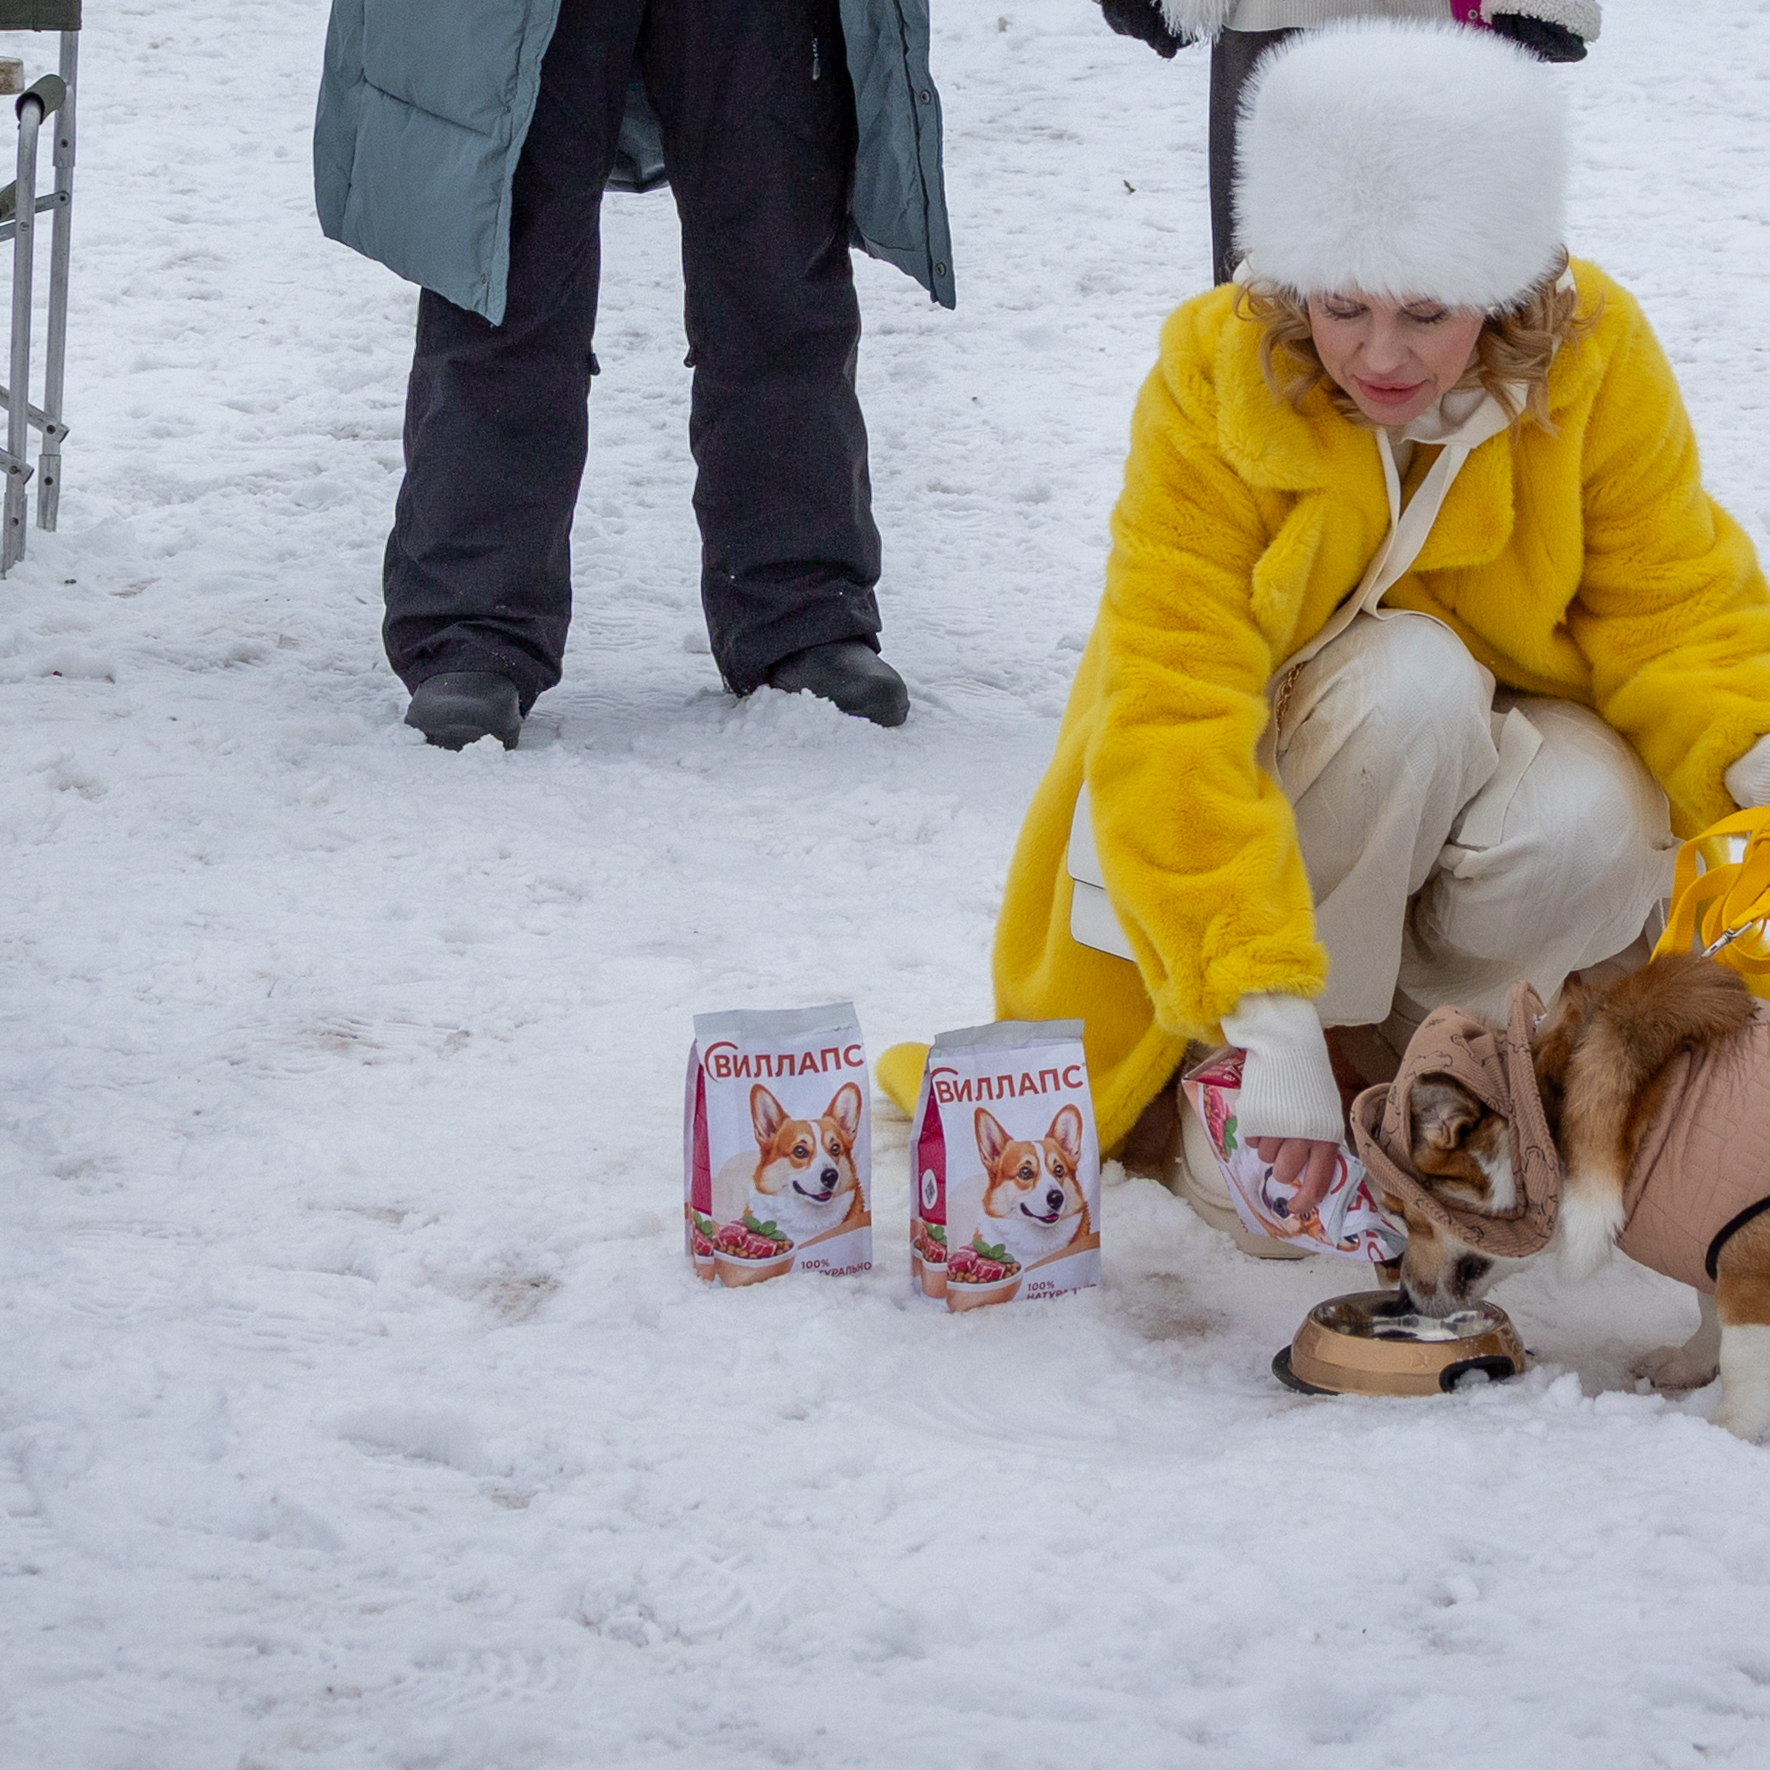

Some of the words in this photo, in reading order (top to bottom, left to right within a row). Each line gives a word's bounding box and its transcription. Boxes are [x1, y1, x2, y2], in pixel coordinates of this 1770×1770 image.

[713, 1043, 865, 1079] ВИЛЛАПС
[935, 1064, 1084, 1104] ВИЛЛАПС
[801, 1258, 830, 1270] 100%
[1027, 1280, 1055, 1292] 100%
